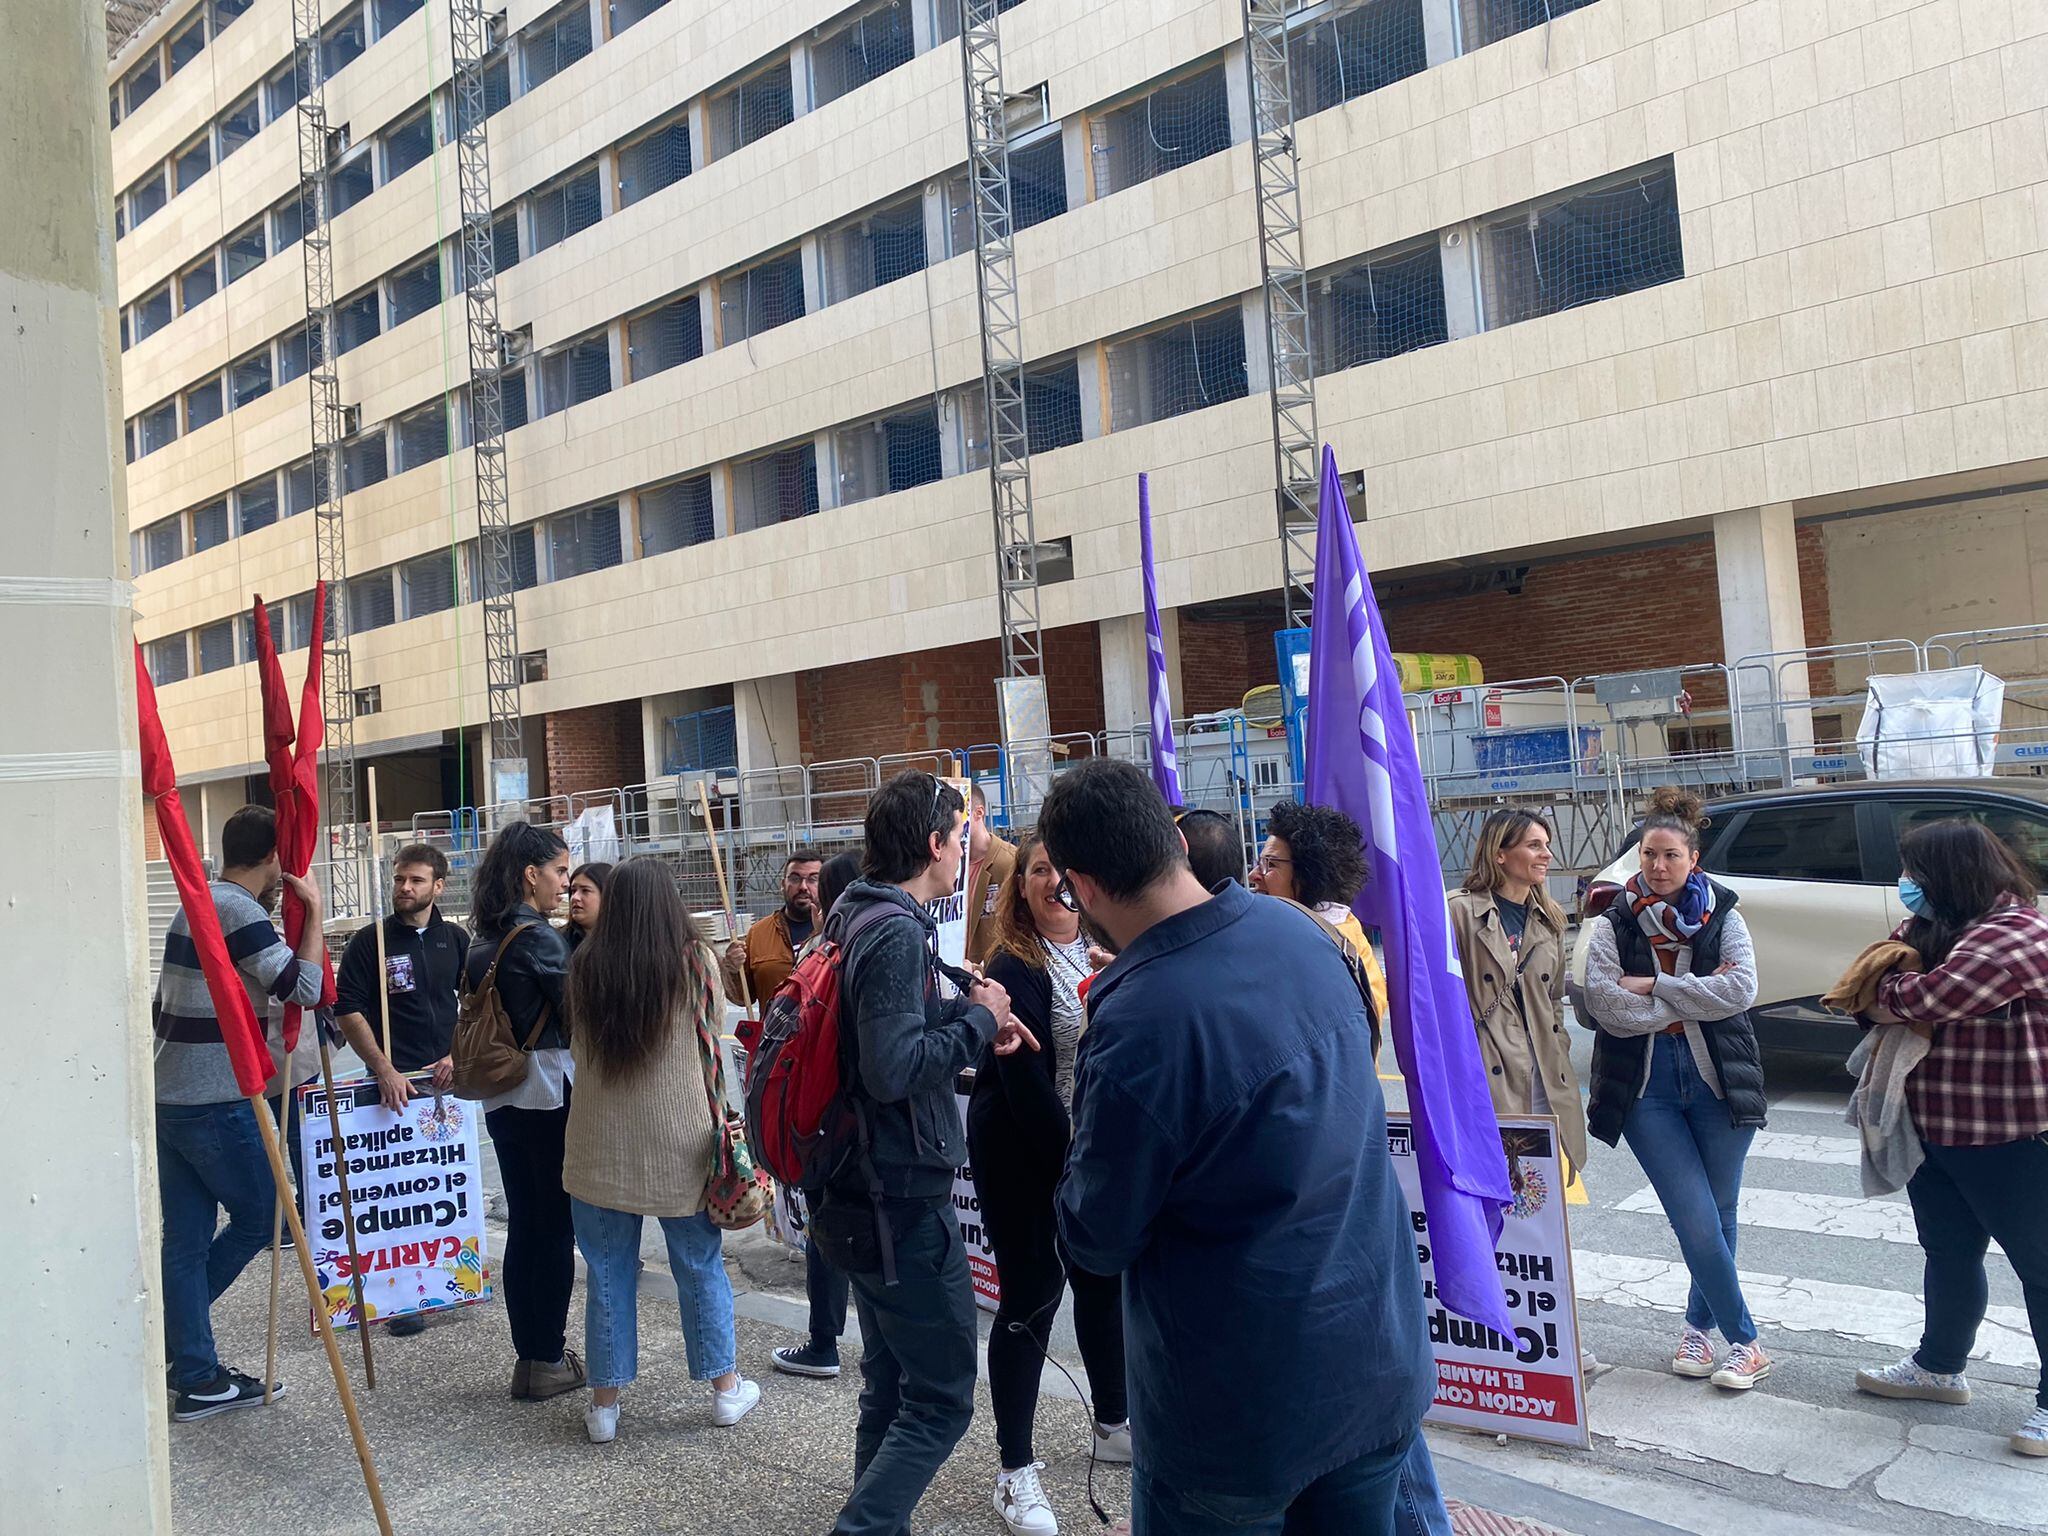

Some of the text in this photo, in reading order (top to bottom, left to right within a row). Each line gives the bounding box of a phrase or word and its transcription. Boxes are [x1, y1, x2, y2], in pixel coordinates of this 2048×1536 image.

[445, 1171, 467, 1187] el
[336, 1236, 462, 1279] CÁRITAS
[1528, 1290, 1557, 1317] el
[1438, 1363, 1525, 1391] EL HAMB
[1477, 1389, 1557, 1417] ACCIÓN
